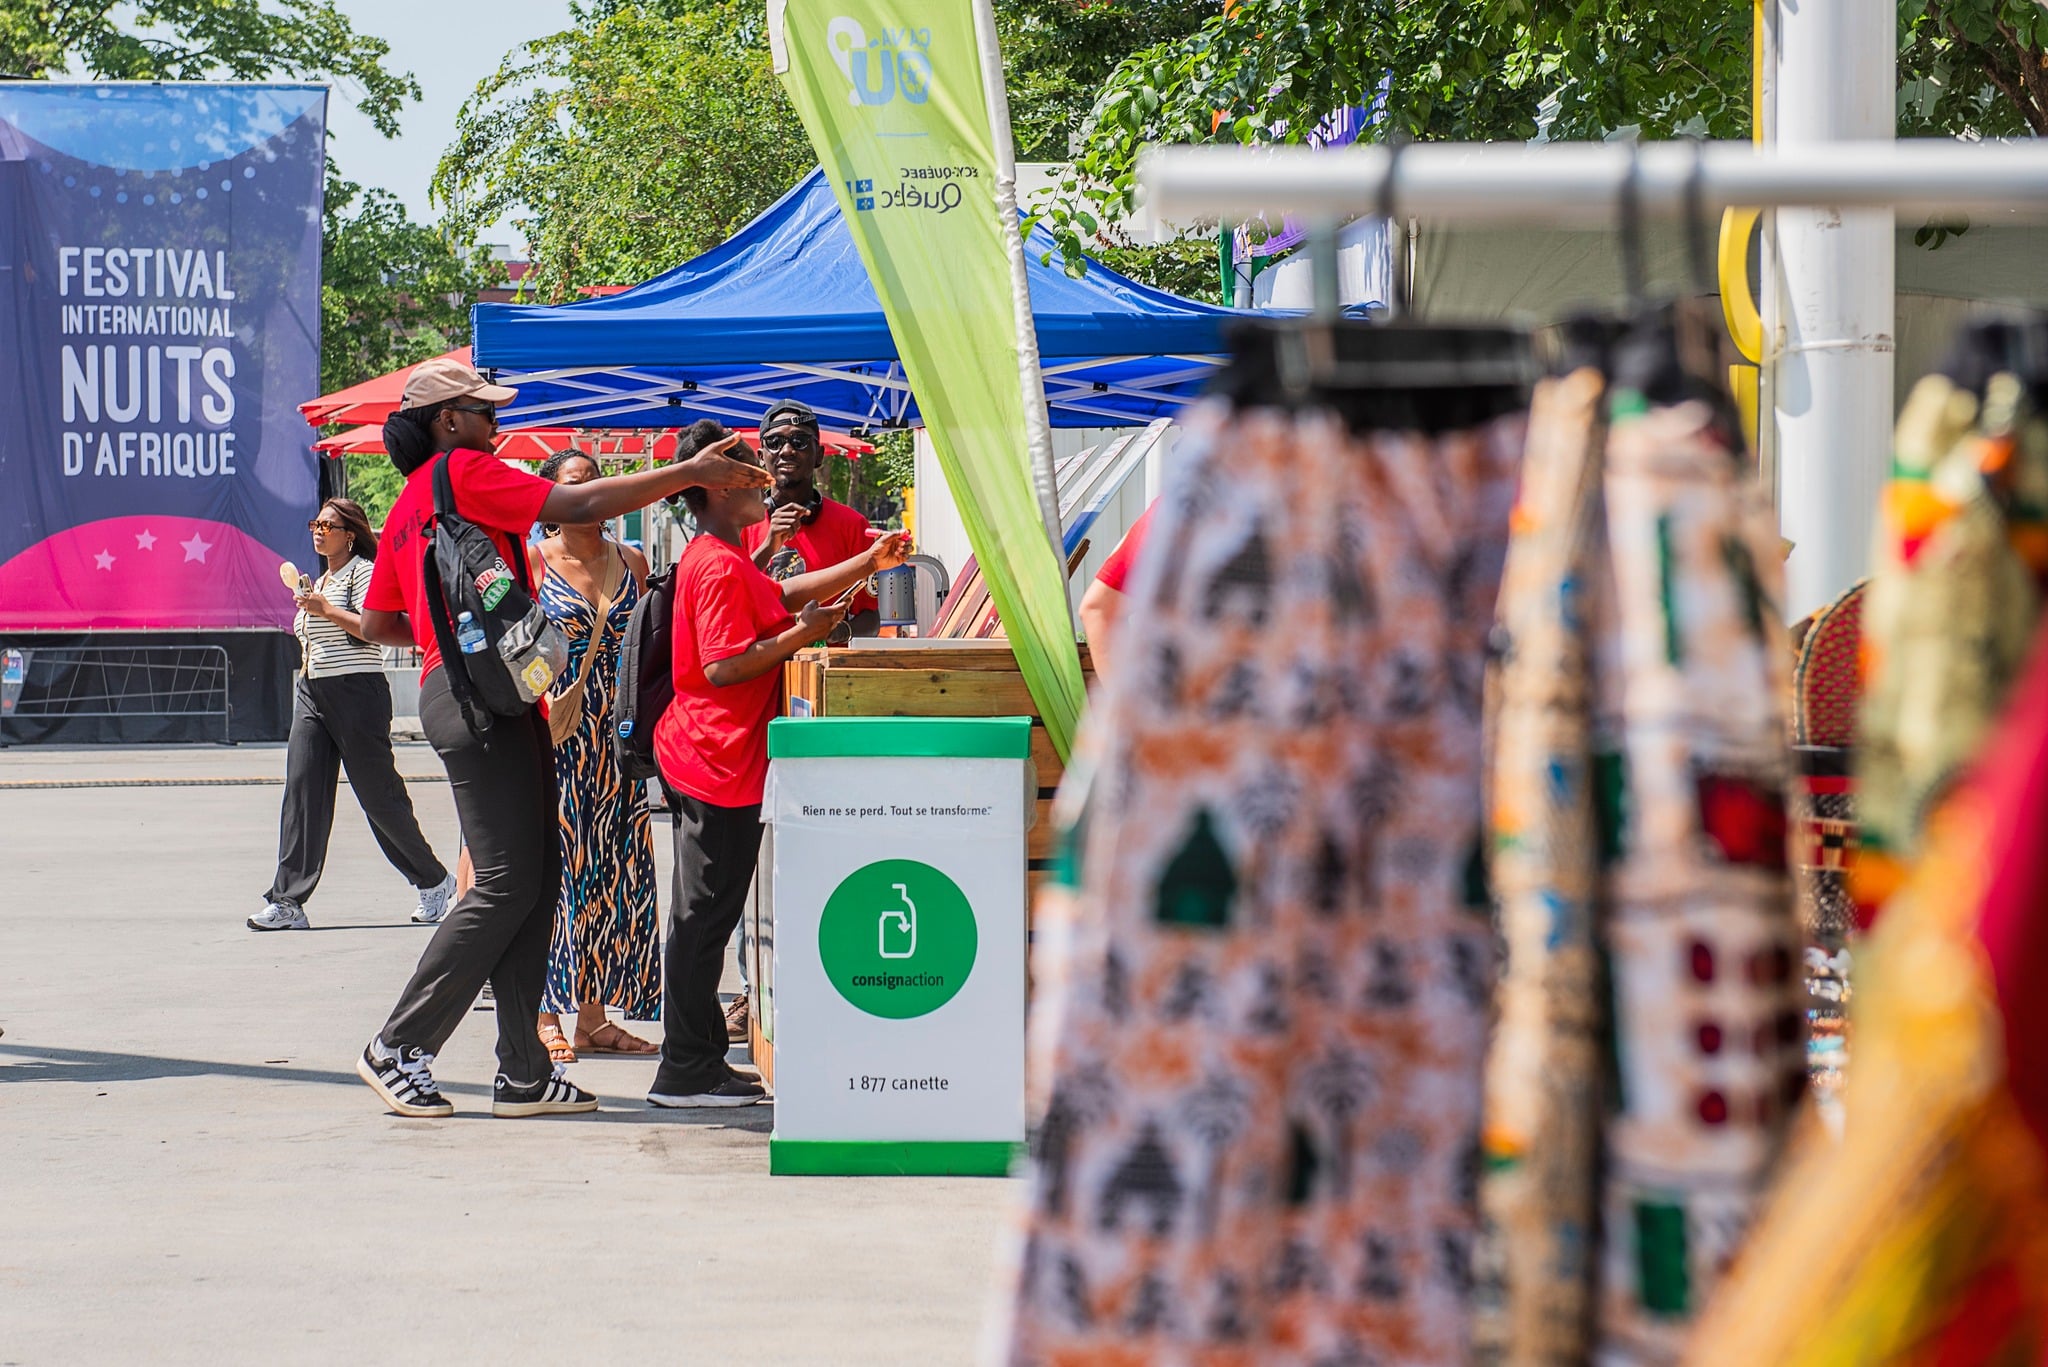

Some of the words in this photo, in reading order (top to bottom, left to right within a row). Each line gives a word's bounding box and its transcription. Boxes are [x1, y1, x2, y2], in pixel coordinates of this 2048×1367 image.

[59, 247, 235, 300] FESTIVAL
[61, 305, 235, 338] INTERNATIONAL
[62, 345, 236, 425] NUITS
[63, 432, 236, 478] D'AFRIQUE
[802, 804, 826, 817] Rien
[828, 807, 842, 817] ne
[844, 807, 857, 817] se
[859, 804, 887, 819] perd.
[889, 804, 913, 817] Tout
[915, 807, 928, 817] se
[851, 971, 944, 990] consignaction
[848, 1077, 855, 1091] 1
[860, 1075, 887, 1093] 877
[891, 1075, 949, 1091] canette
